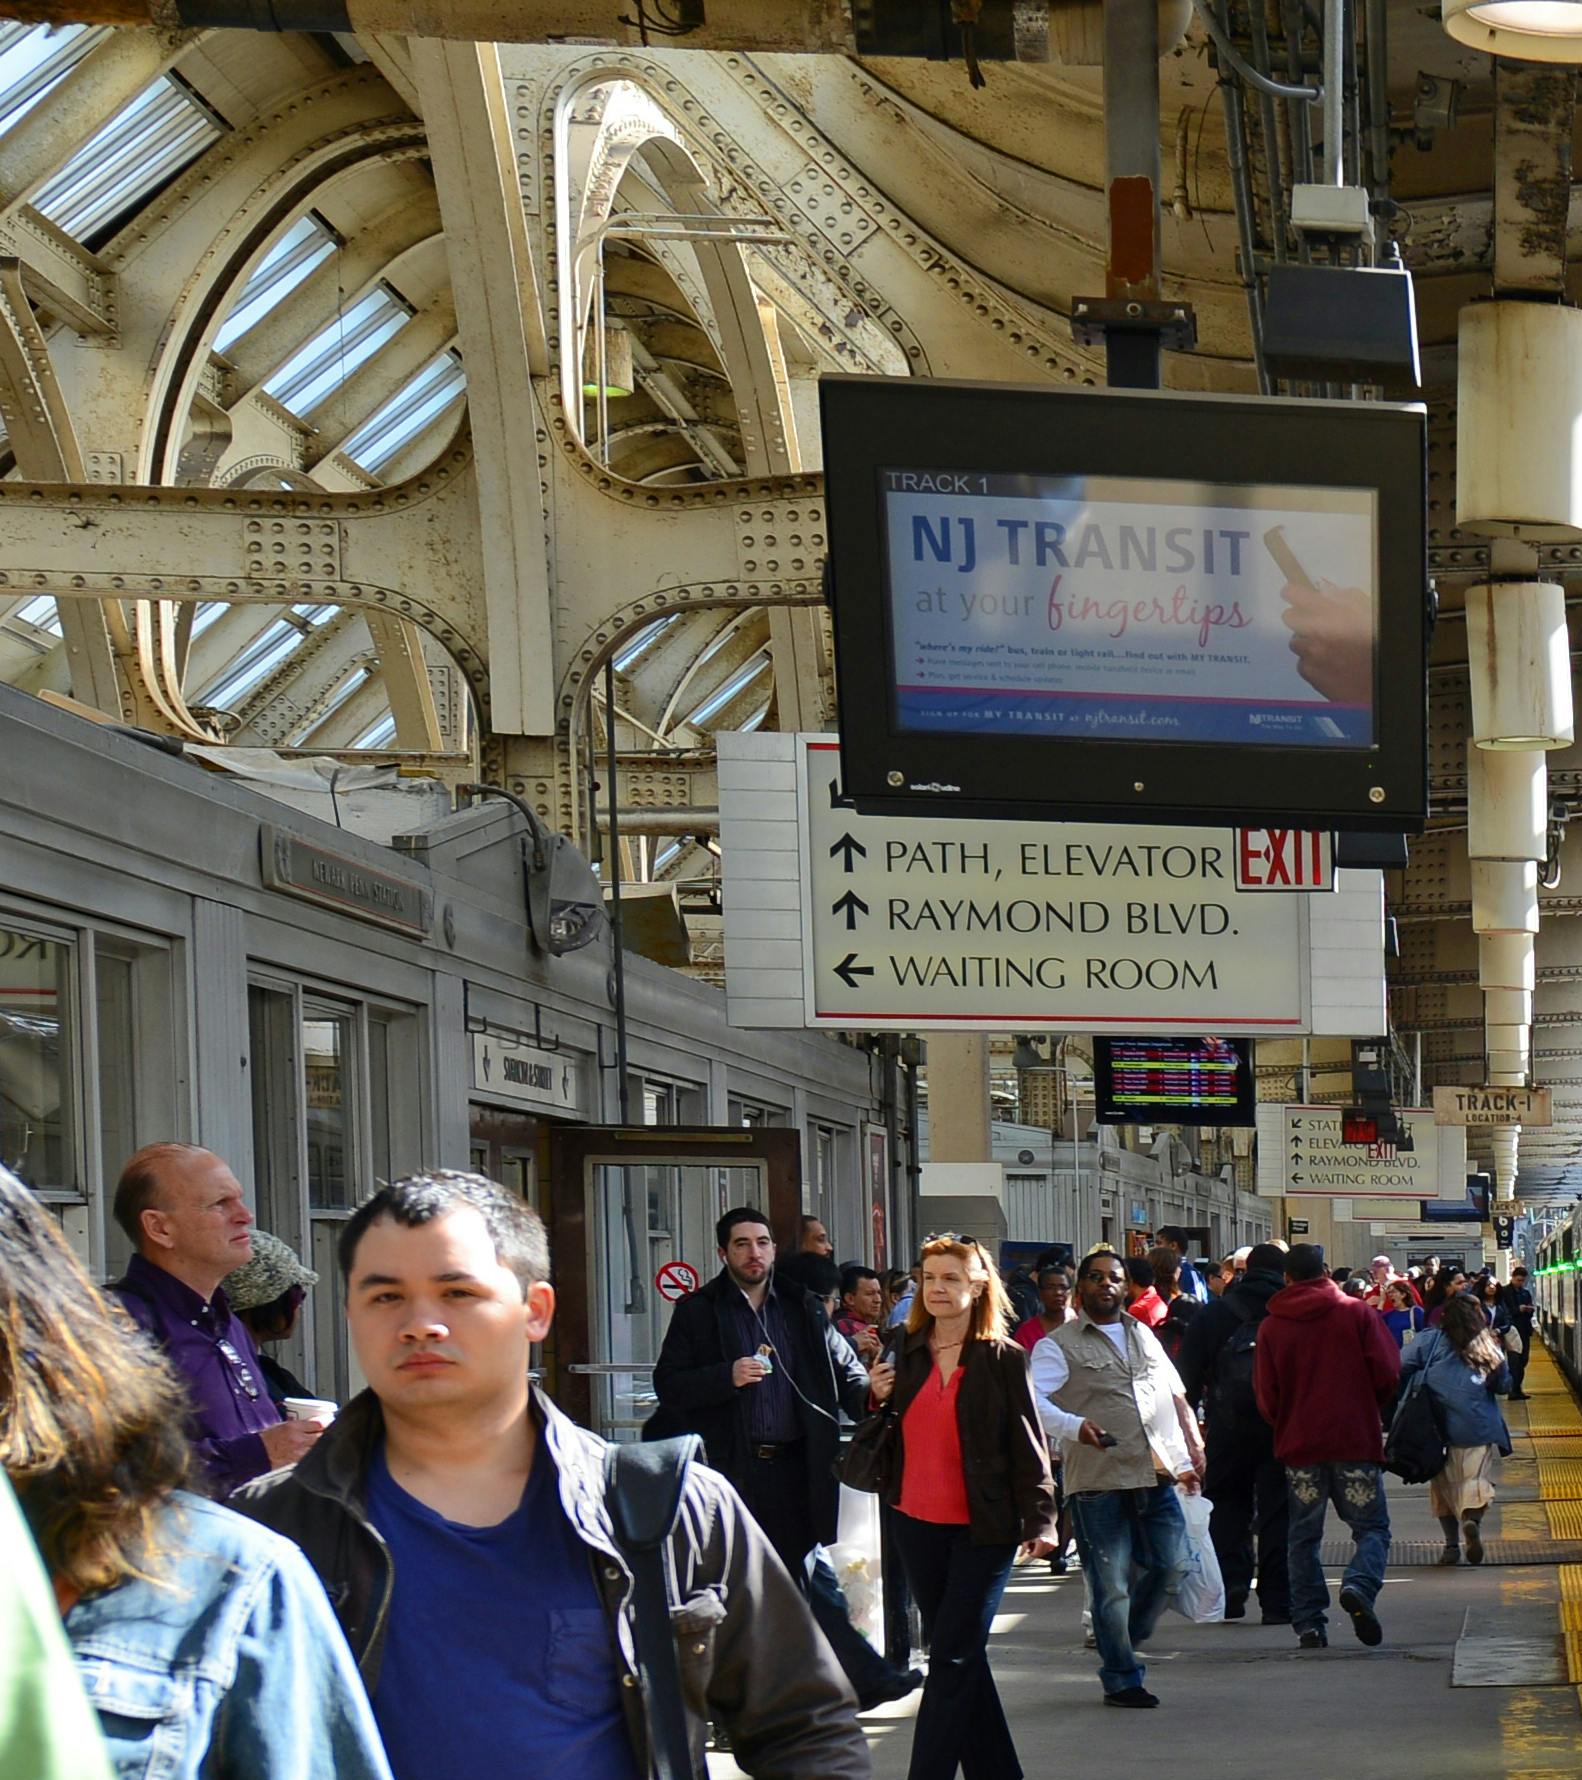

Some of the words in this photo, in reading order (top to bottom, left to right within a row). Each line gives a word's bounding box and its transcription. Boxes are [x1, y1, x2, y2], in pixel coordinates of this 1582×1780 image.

[886, 472, 970, 493] TRACK
[979, 477, 988, 494] 1
[911, 515, 977, 573] NJ
[996, 518, 1250, 576] TRANSIT
[916, 587, 948, 614] at
[960, 592, 1035, 622] your
[1047, 573, 1253, 648] fingertips
[1191, 653, 1204, 662] MY
[1008, 710, 1064, 721] TRANSIT
[885, 841, 1003, 882] PATH,
[1020, 843, 1224, 879] ELEVATOR
[1239, 828, 1324, 885] EXIT
[888, 898, 1110, 934] RAYMOND
[1126, 902, 1240, 936] BLVD.
[888, 955, 1065, 989] WAITING
[1086, 957, 1219, 991] ROOM
[1309, 1155, 1380, 1168] RAYMOND
[1367, 1142, 1394, 1160] EXIT
[1309, 1173, 1366, 1185] WAITING
[1370, 1174, 1414, 1186] ROOM
